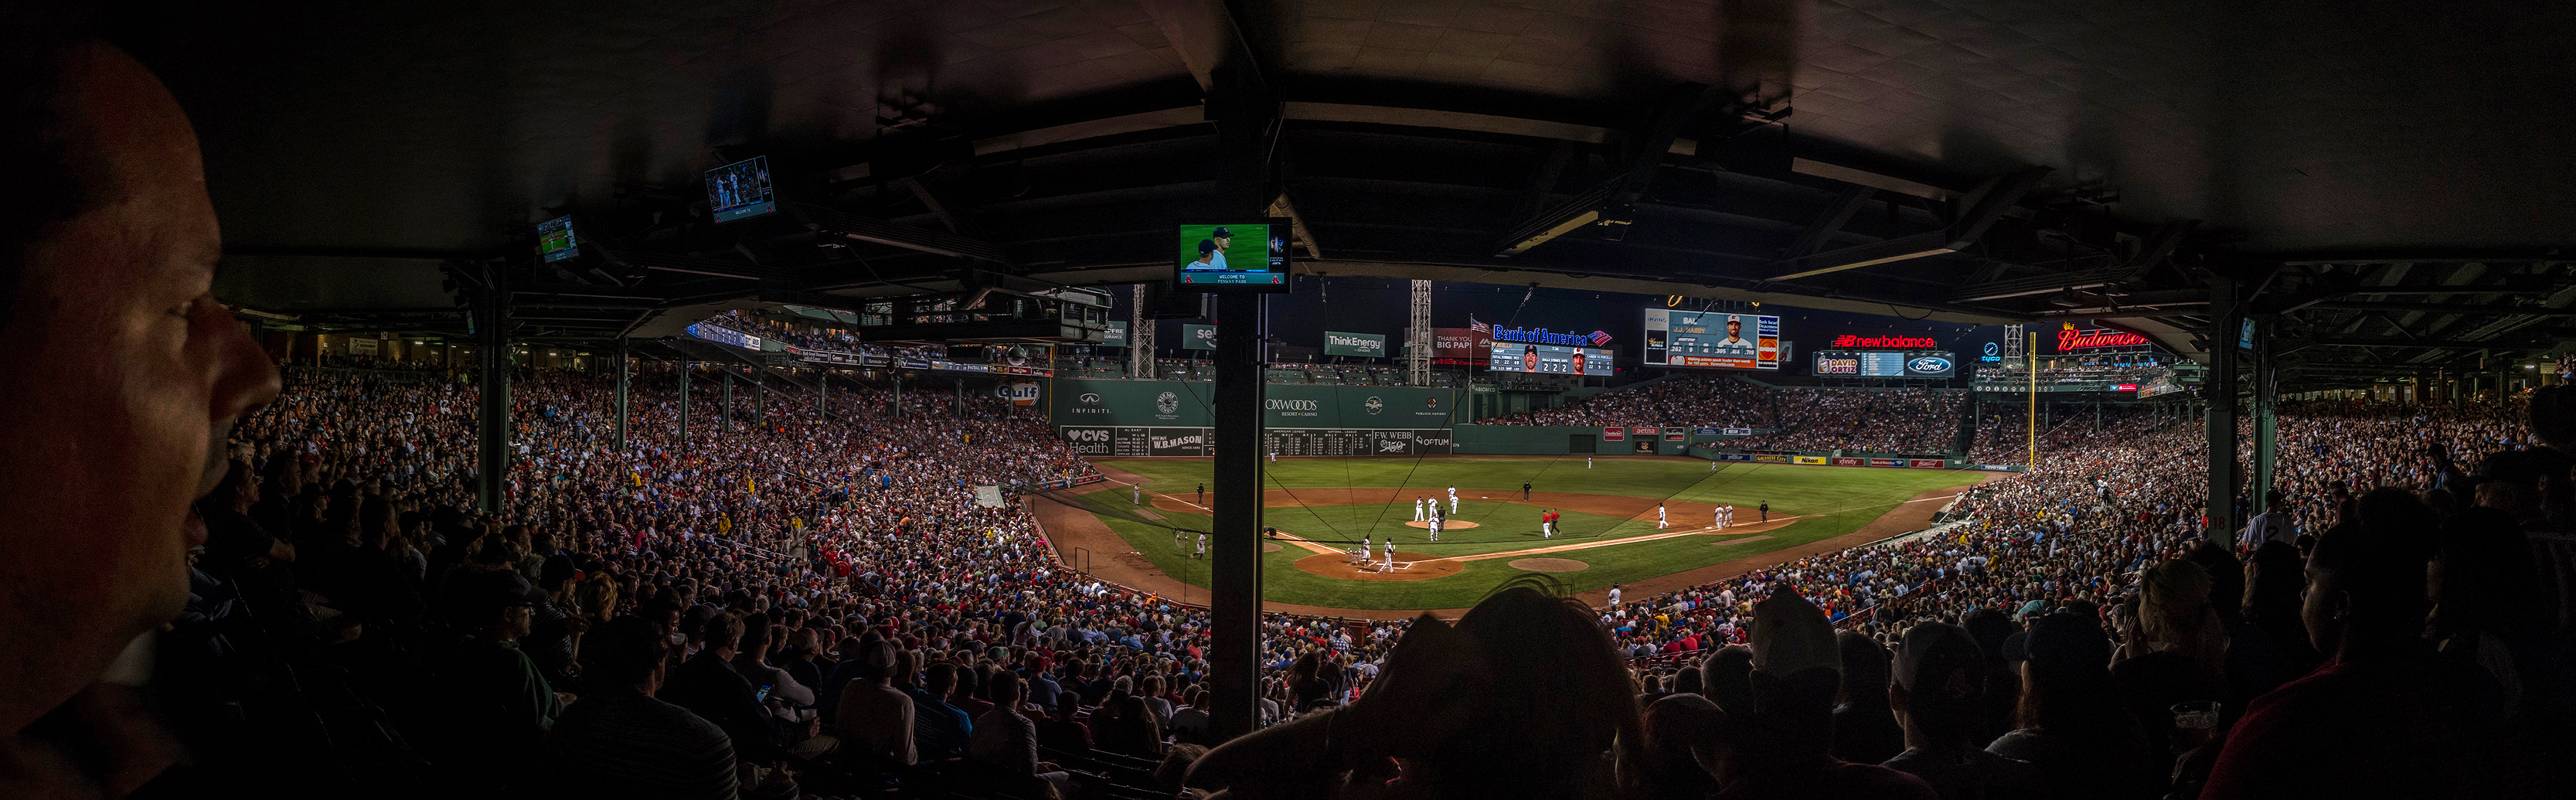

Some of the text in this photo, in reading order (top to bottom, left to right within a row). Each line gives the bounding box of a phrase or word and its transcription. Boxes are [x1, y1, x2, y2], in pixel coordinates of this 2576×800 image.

[1329, 335, 1381, 349] ThinkEnergy
[1493, 325, 1587, 346] Bank of America
[2057, 329, 2150, 352] Budweiser
[1915, 359, 1942, 371] Ford
[999, 385, 1037, 398] Gulf
[1159, 400, 1178, 413] SCHOLARS
[1265, 399, 1318, 410] OXWOODS
[1081, 430, 1110, 441] CVS
[1153, 435, 1203, 449] W.B.MASON
[1069, 441, 1109, 454] Health
[2213, 516, 2226, 530] 18
[2266, 525, 2279, 542] 2
